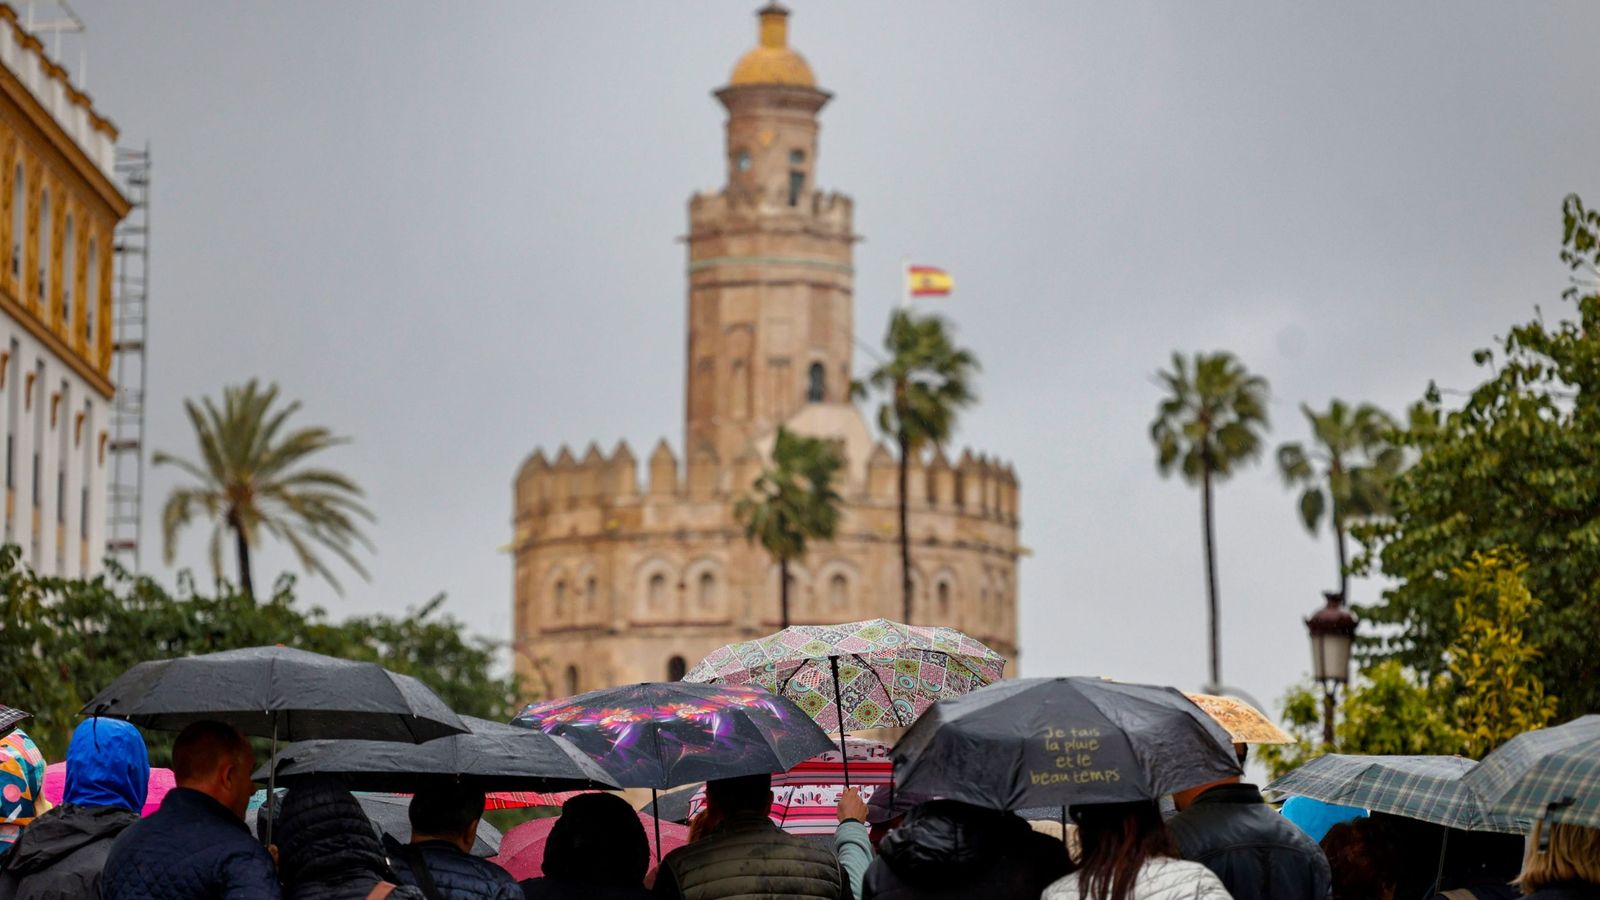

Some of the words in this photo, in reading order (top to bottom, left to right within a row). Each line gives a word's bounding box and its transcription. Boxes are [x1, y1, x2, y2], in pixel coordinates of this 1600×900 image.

[1044, 727, 1066, 739] Je
[1045, 739, 1060, 752] la
[1064, 738, 1100, 753] pluie
[1055, 755, 1074, 768] et
[1077, 753, 1092, 767] le
[1030, 769, 1069, 785] beau
[1073, 767, 1120, 783] temps
